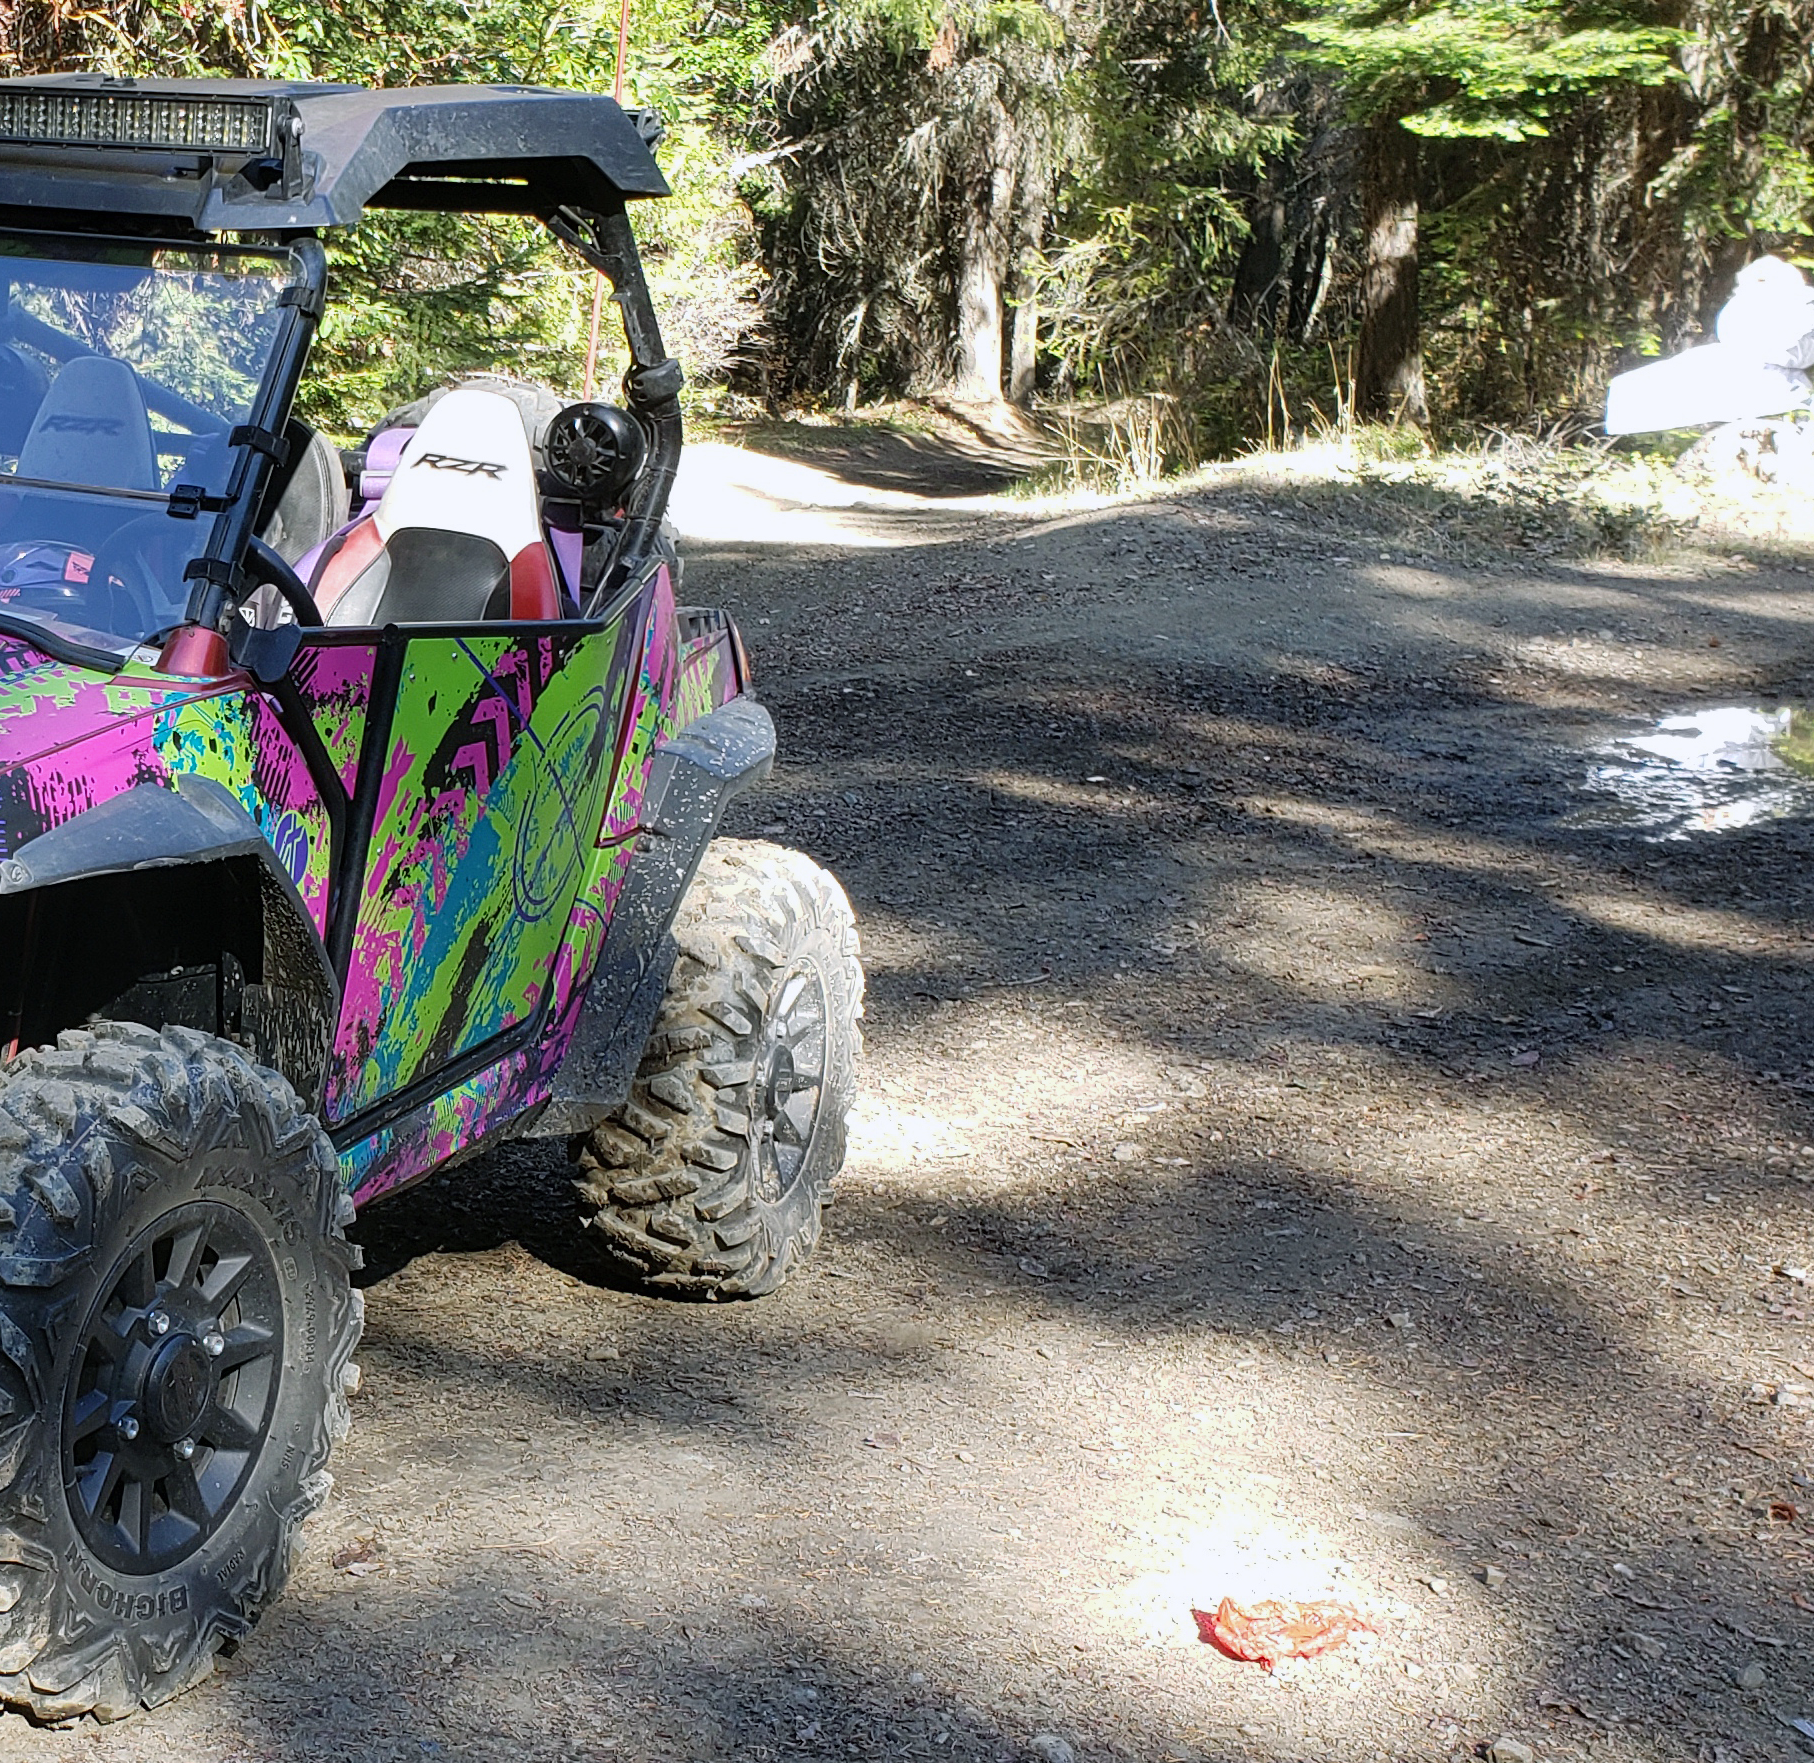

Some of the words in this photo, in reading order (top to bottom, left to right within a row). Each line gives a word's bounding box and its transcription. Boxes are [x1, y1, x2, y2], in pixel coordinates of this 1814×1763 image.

[409, 452, 508, 482] RZR
[64, 1540, 190, 1621] BIGHORN
[215, 1547, 247, 1583] RADIAL
